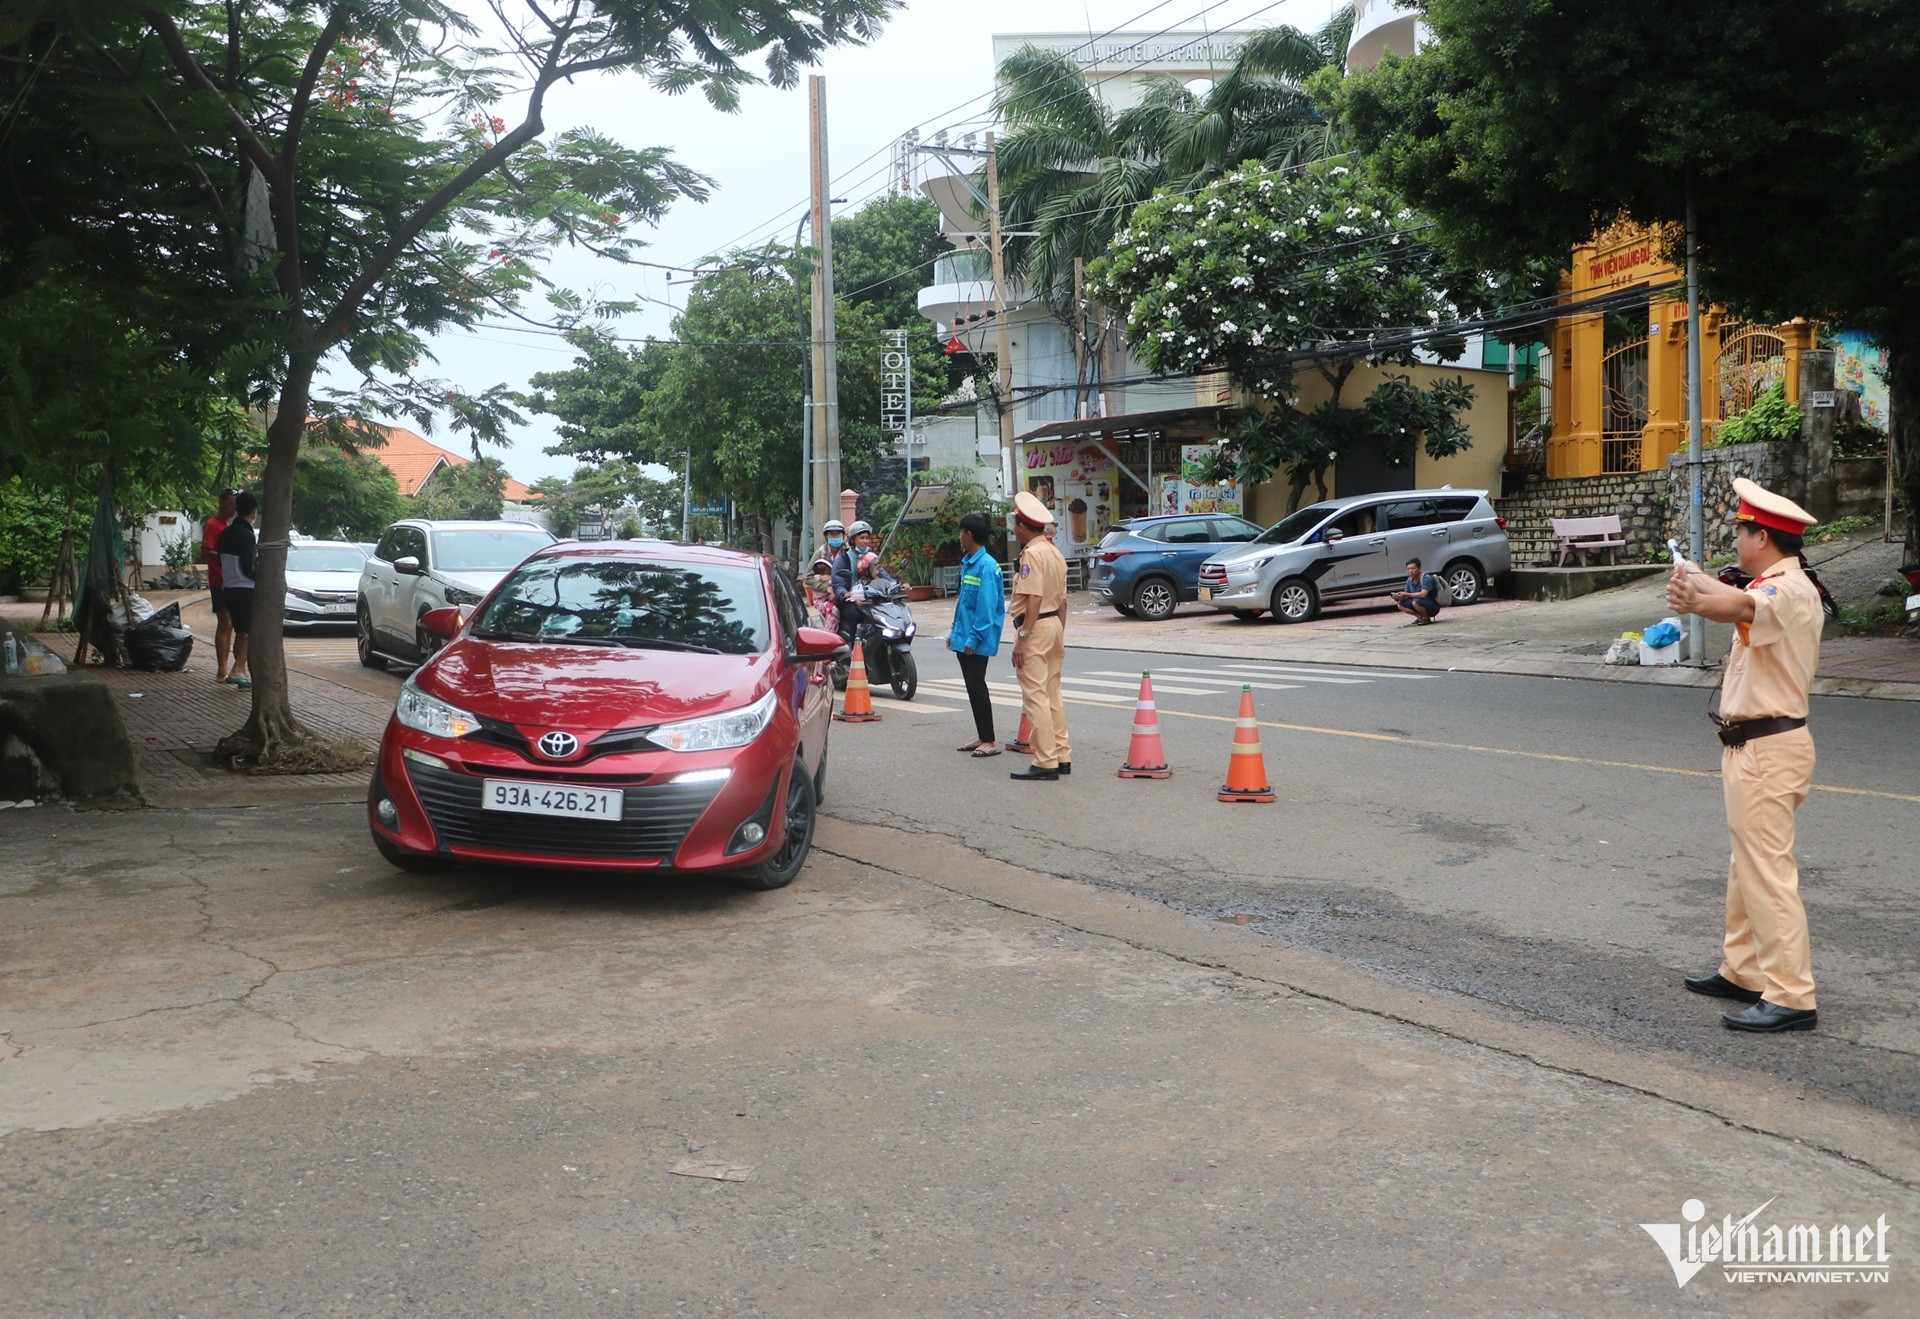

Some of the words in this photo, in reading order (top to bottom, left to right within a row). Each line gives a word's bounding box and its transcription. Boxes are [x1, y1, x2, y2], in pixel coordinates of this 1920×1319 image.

[1106, 43, 1150, 63] HOTEL
[1153, 43, 1164, 62] &
[884, 330, 905, 432] HOTEL
[495, 786, 608, 813] 93A-426.21
